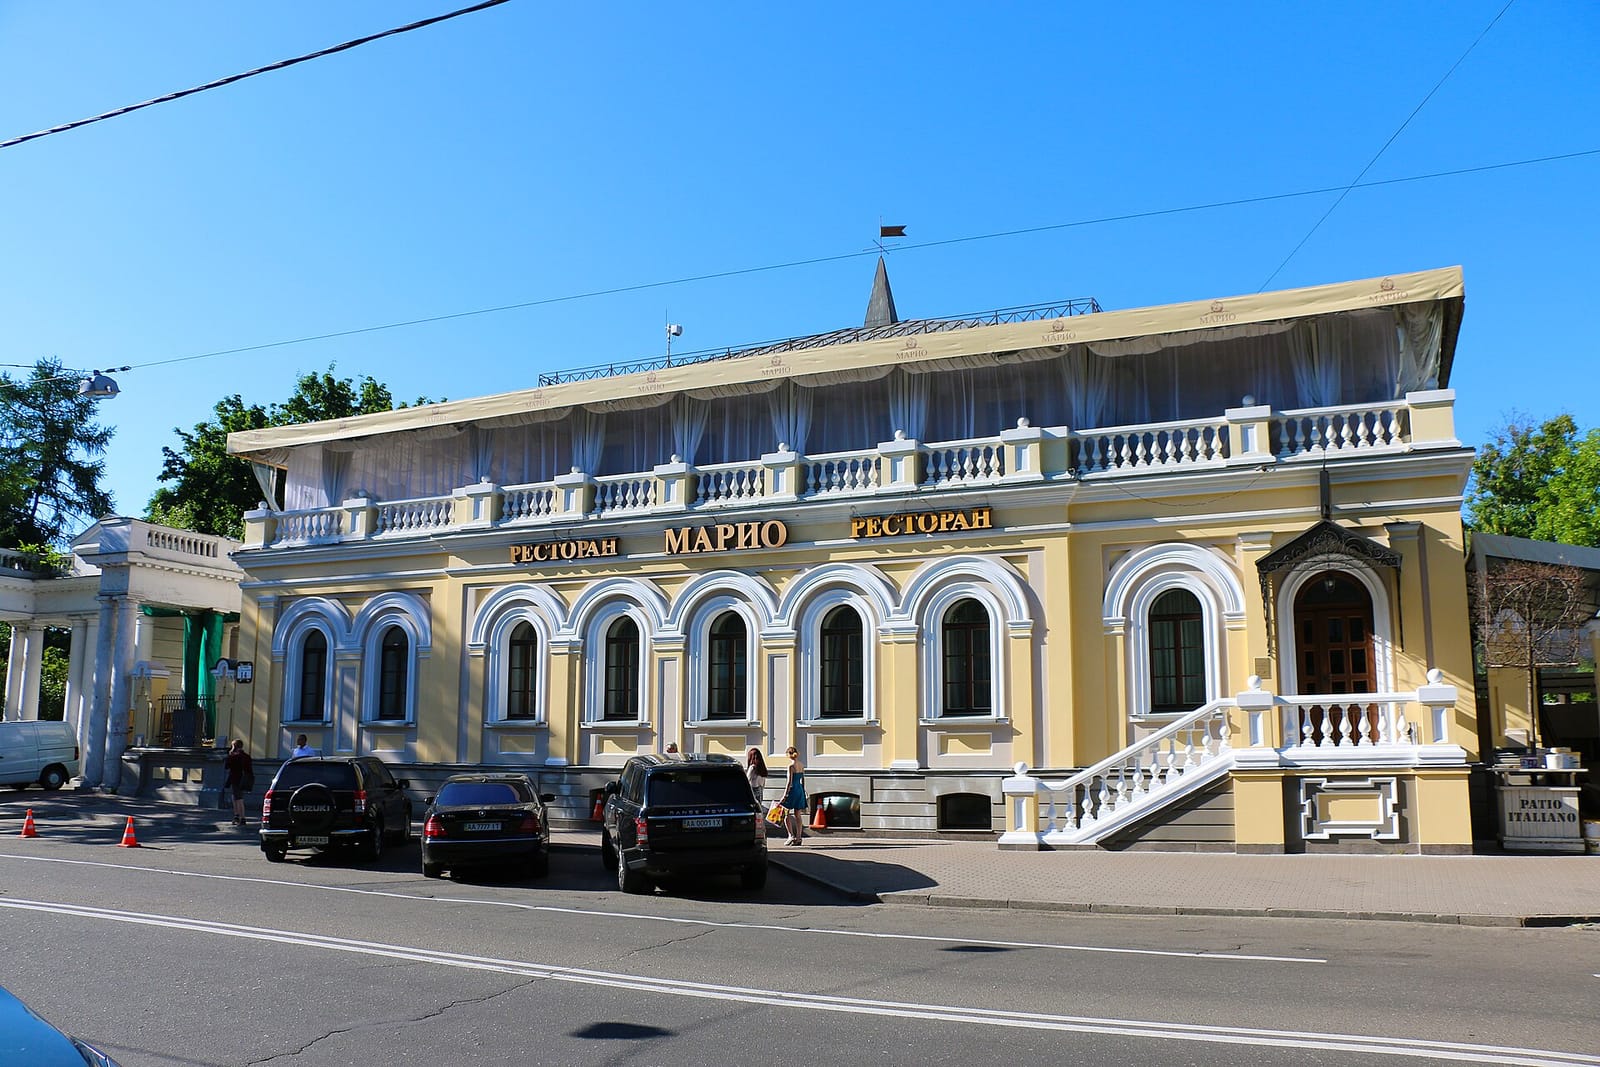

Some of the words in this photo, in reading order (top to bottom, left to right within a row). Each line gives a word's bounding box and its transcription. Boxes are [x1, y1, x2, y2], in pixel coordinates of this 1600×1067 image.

[1199, 312, 1237, 325] МАРИО
[1041, 332, 1077, 343] МАРИО
[896, 350, 928, 360] МАРИО
[761, 367, 791, 377] МАРИО
[849, 506, 993, 539] РЕСТОРАН
[663, 519, 788, 555] МАРИО
[509, 536, 621, 564] РЕСТОРАН
[293, 804, 330, 812] SUZUKI
[1520, 799, 1563, 810] PATIO
[1508, 812, 1577, 823] ITALIANO
